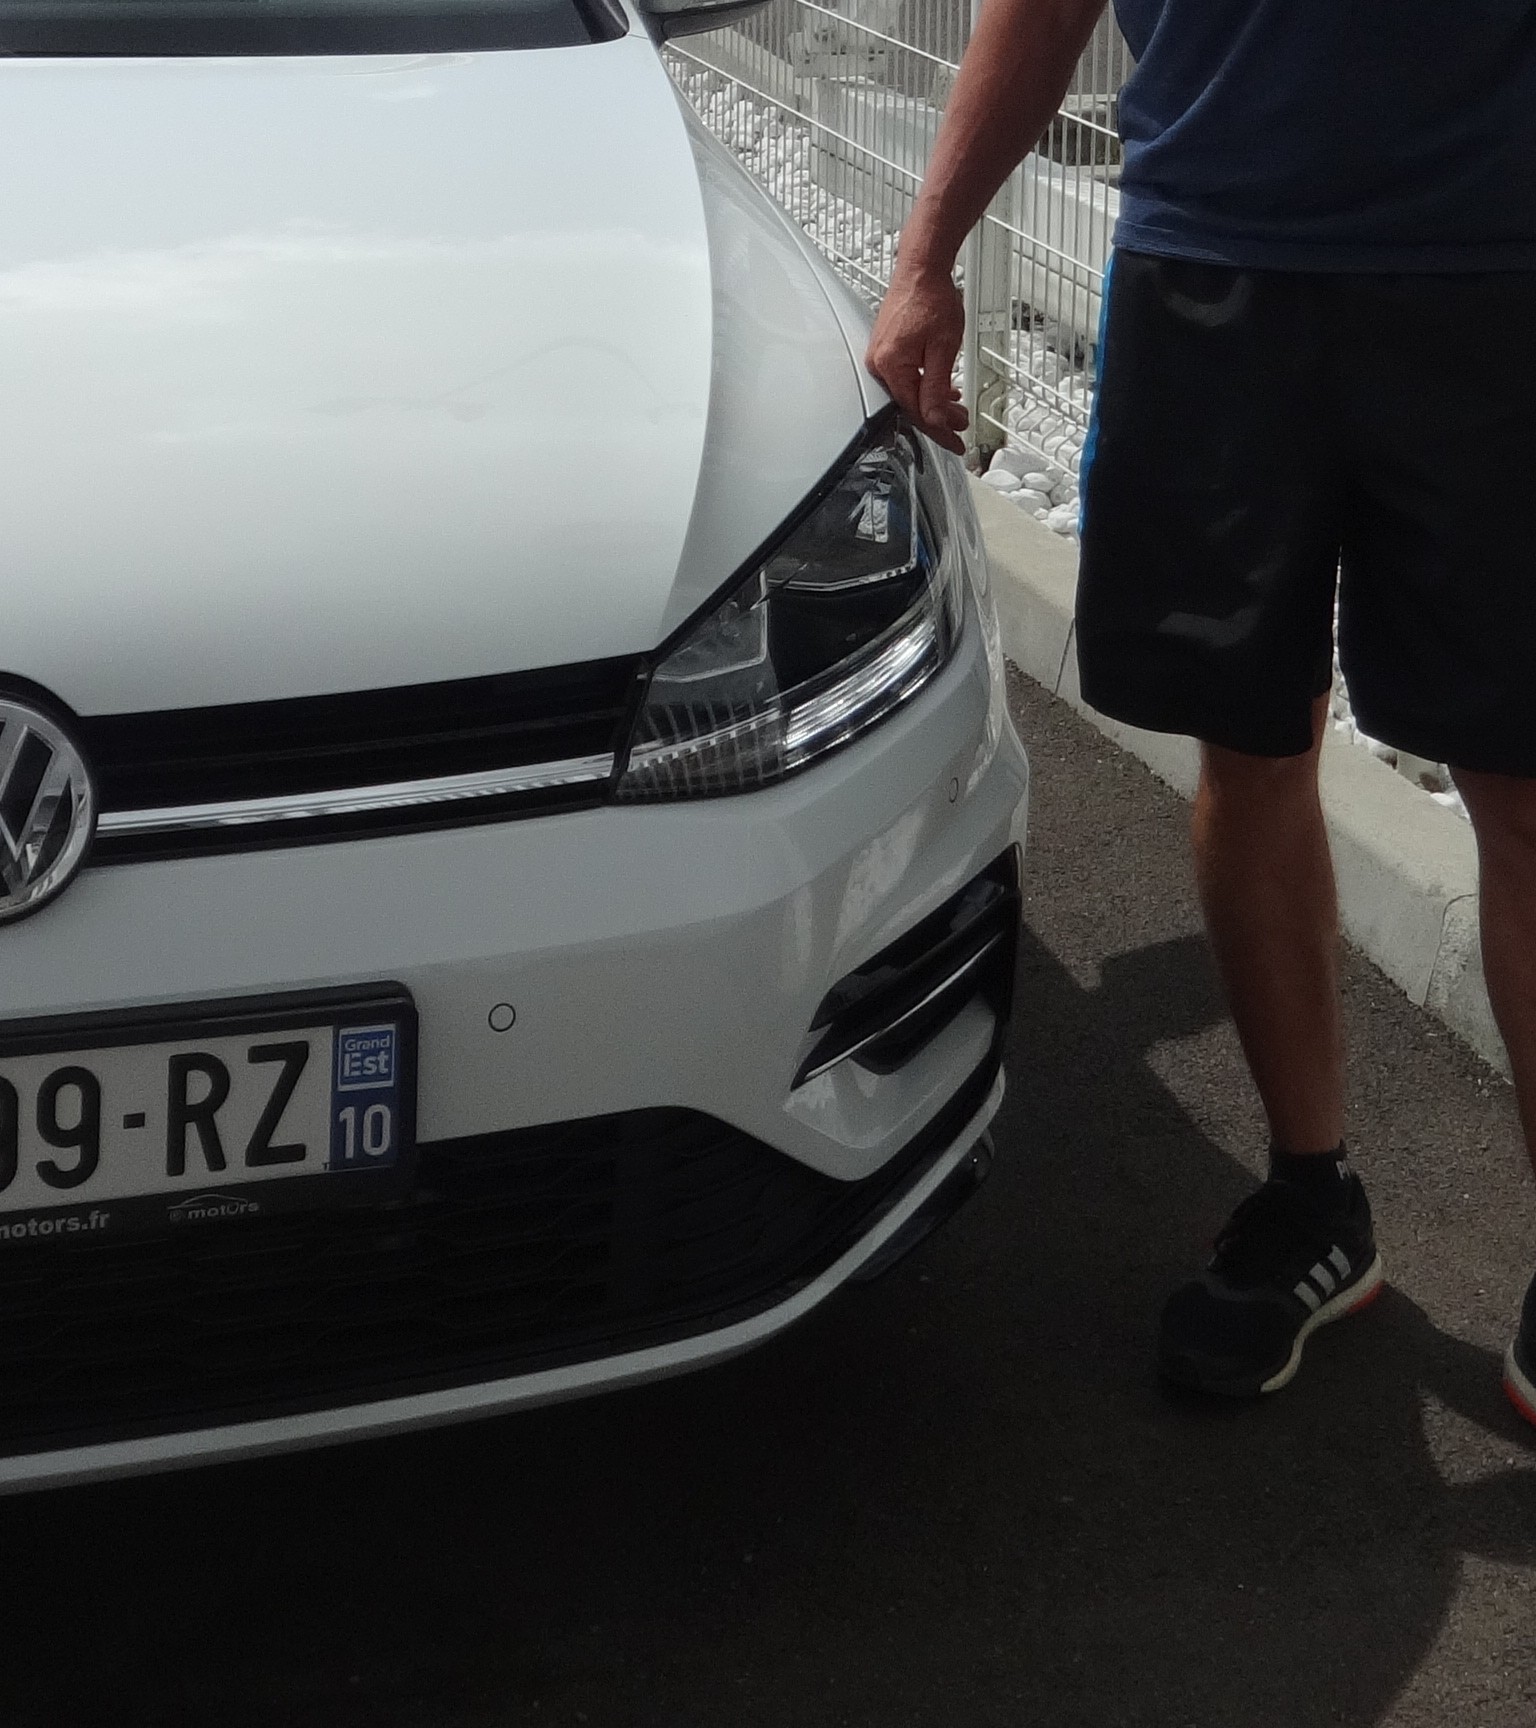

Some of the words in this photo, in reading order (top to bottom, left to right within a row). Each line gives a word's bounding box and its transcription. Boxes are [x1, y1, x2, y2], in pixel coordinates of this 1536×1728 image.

[344, 1035, 391, 1052] Grand
[343, 1051, 390, 1078] Est
[338, 1103, 392, 1160] 10
